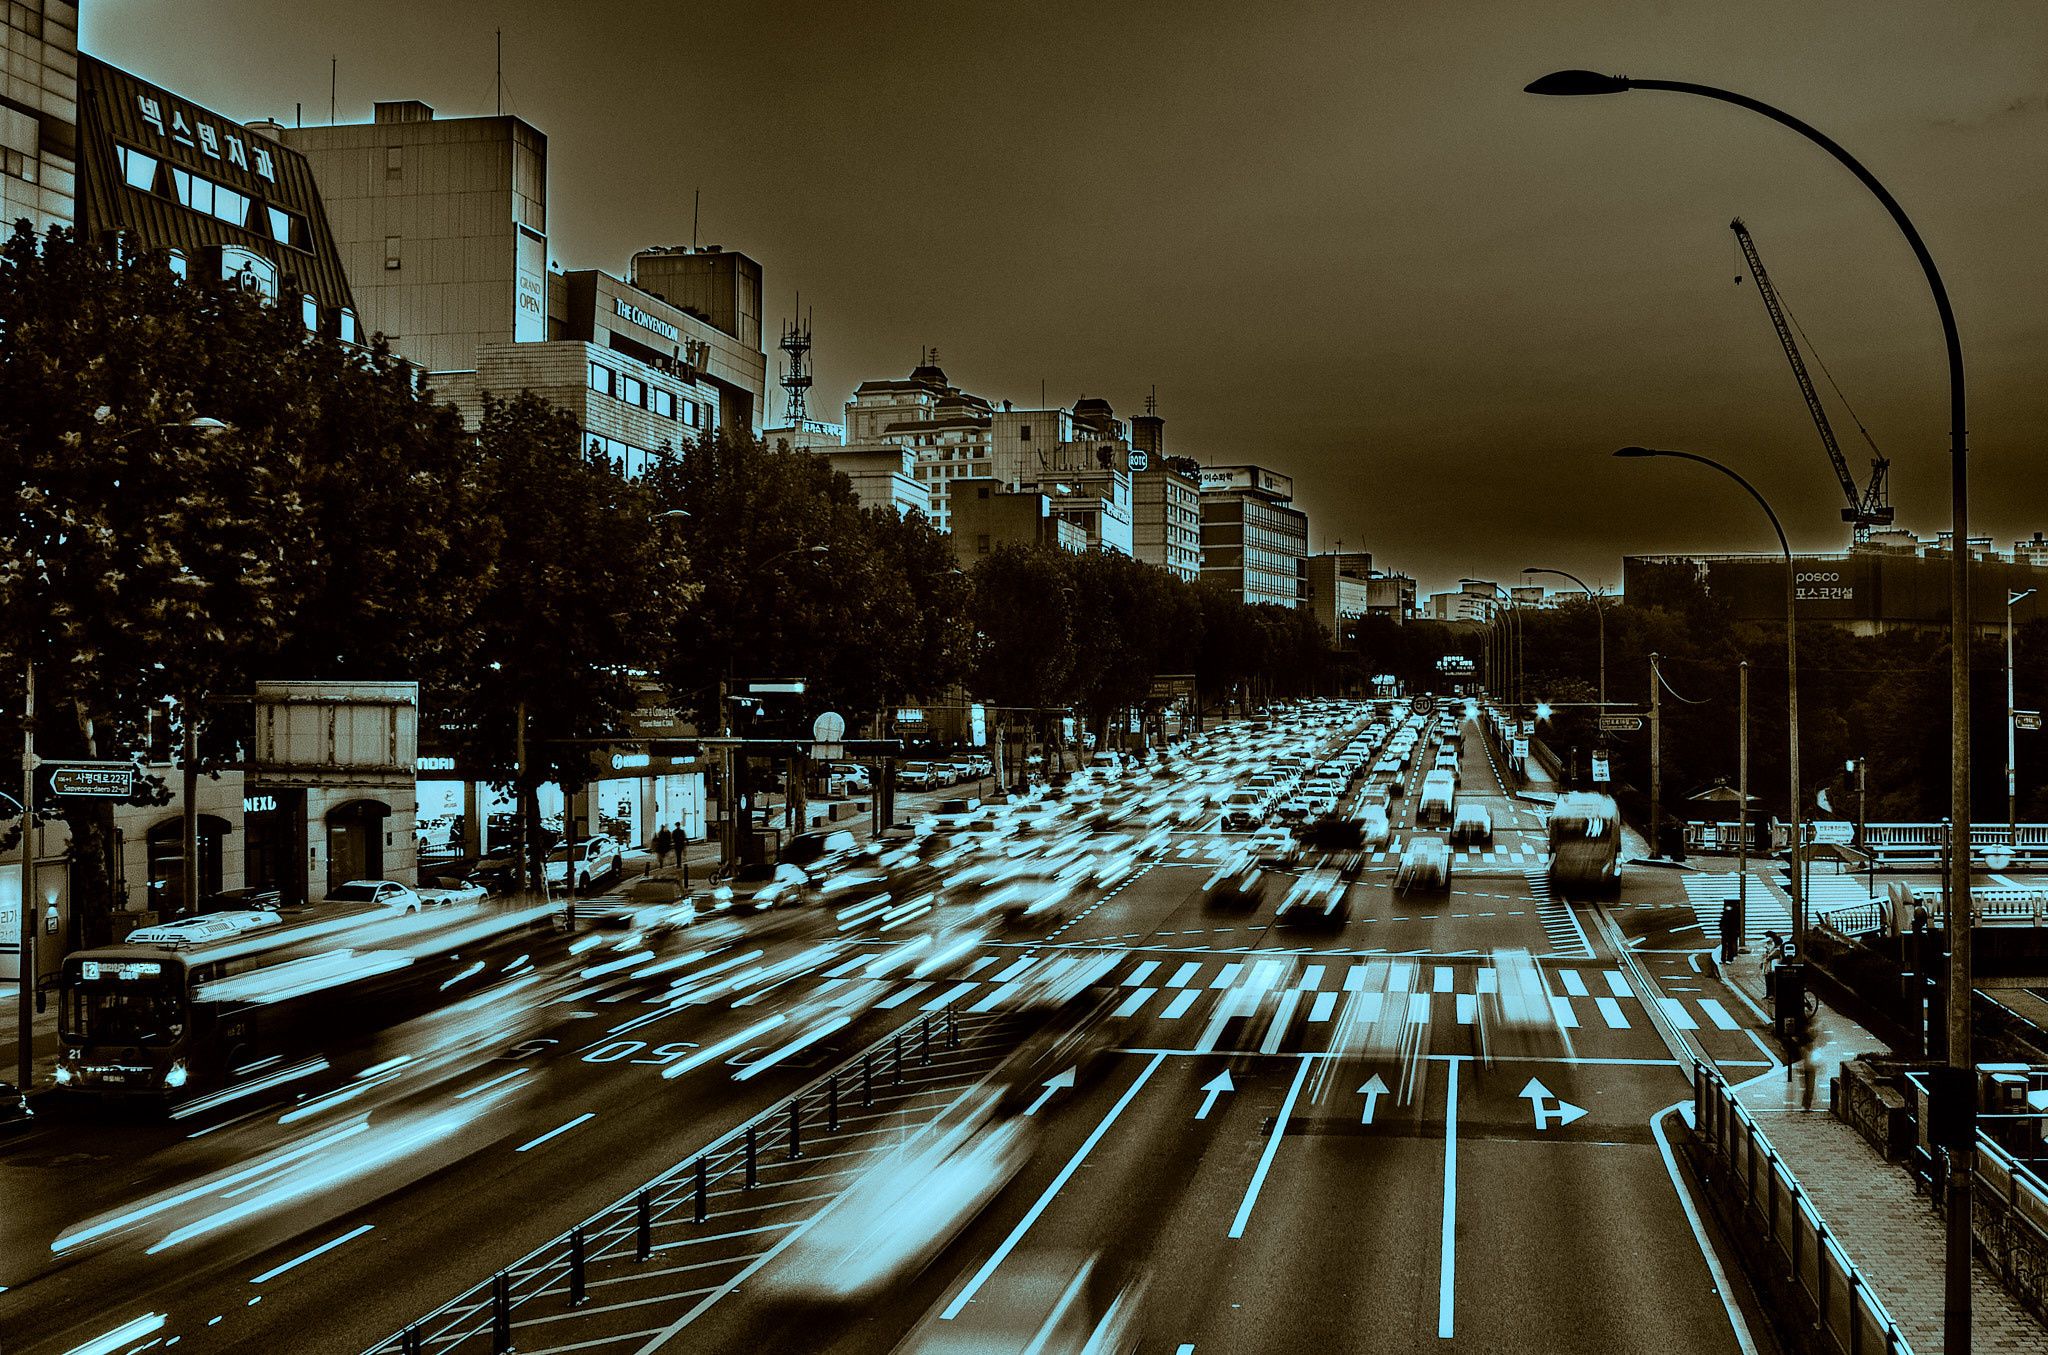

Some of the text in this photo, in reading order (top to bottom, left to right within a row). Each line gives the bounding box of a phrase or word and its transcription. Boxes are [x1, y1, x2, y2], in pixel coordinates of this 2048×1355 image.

[137, 95, 275, 183] 넥스덴치과
[519, 276, 541, 295] GRAND
[519, 292, 541, 314] OPEN
[616, 298, 679, 342] THE CONVENTION
[1130, 455, 1146, 466] ROTC
[1796, 572, 1840, 585] posco
[1795, 587, 1853, 600] 포스코건설
[1415, 700, 1430, 710] 50
[69, 1049, 81, 1060] 21
